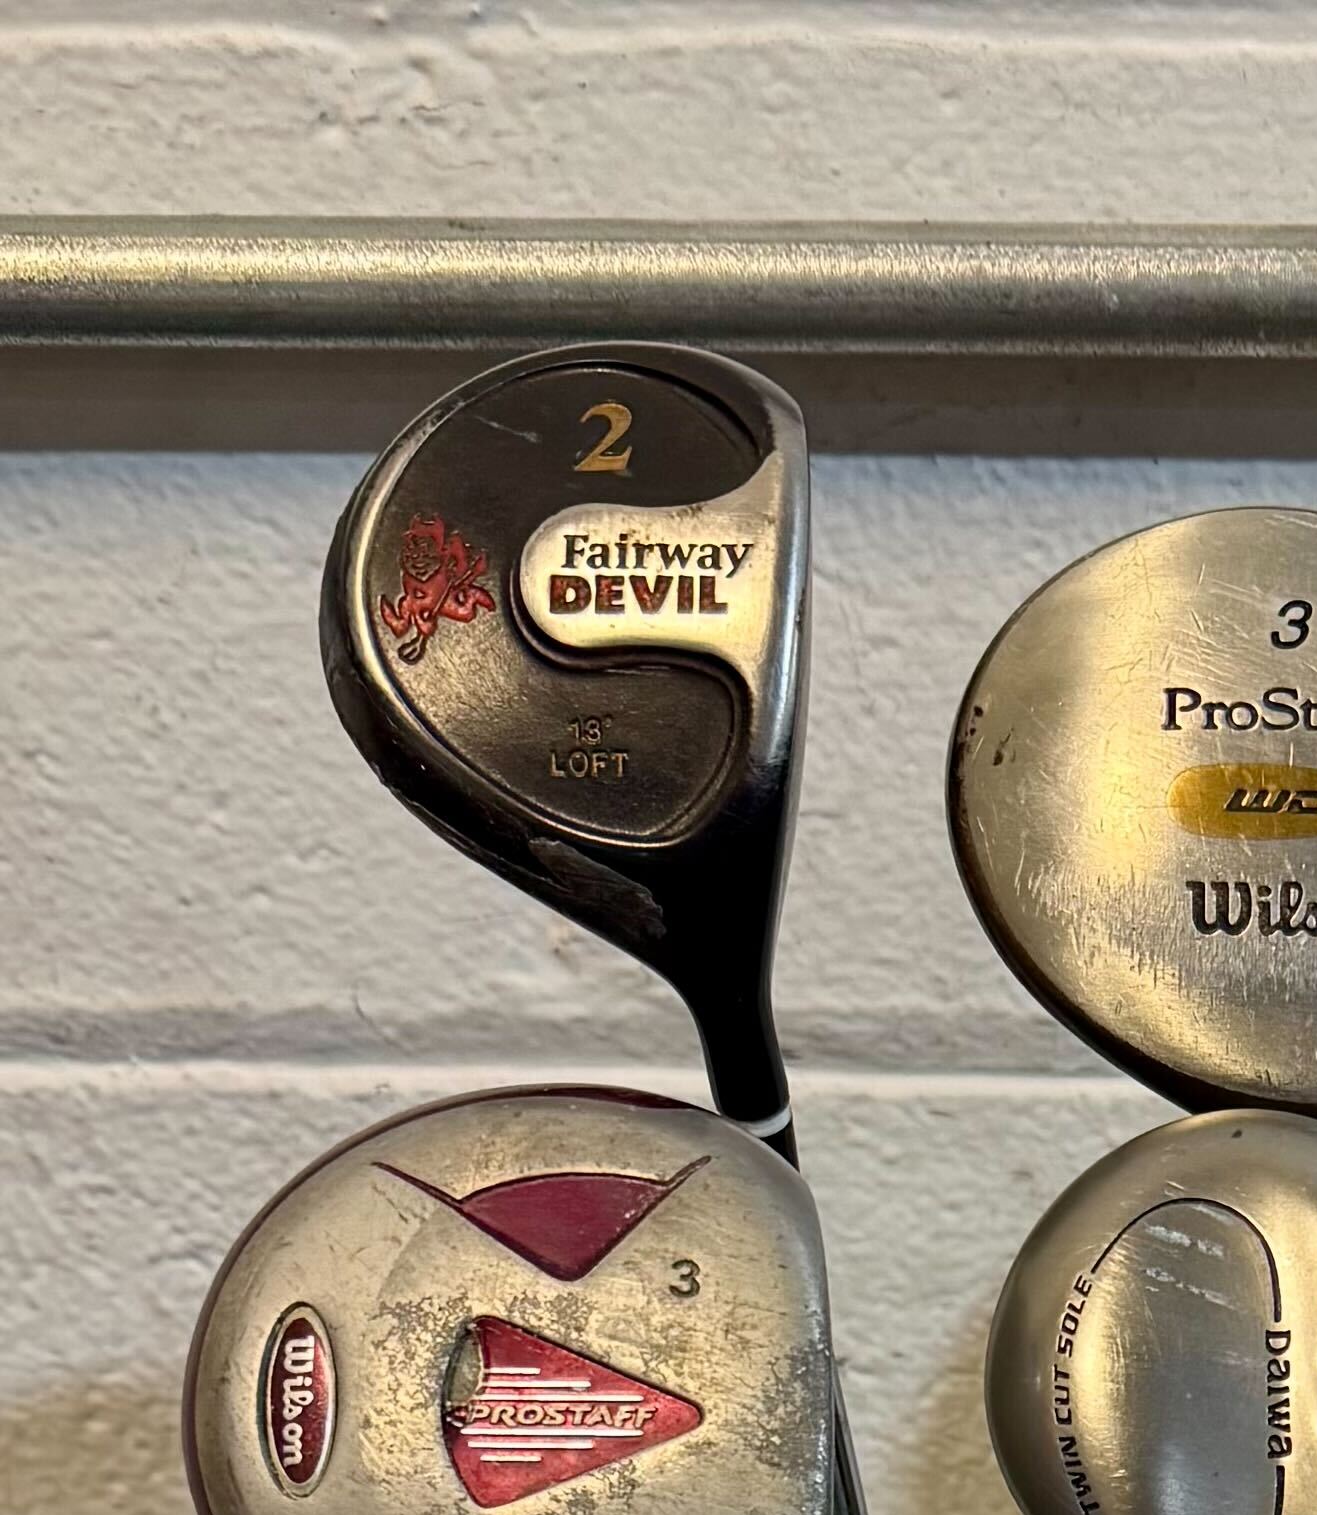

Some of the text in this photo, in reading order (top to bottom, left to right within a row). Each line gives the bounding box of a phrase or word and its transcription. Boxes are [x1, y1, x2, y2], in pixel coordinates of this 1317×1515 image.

[574, 403, 633, 472] 2
[560, 534, 753, 578] Fairway
[549, 575, 728, 615] DEVIL
[1271, 600, 1313, 649] 3
[550, 751, 628, 778] LOFT
[668, 1259, 701, 1298] 3
[282, 1334, 316, 1468] Wilson
[465, 1402, 657, 1429] PROSTAFF
[1053, 1274, 1099, 1515] TWIN CUT SOLE
[1264, 1329, 1292, 1459] Daiwa
